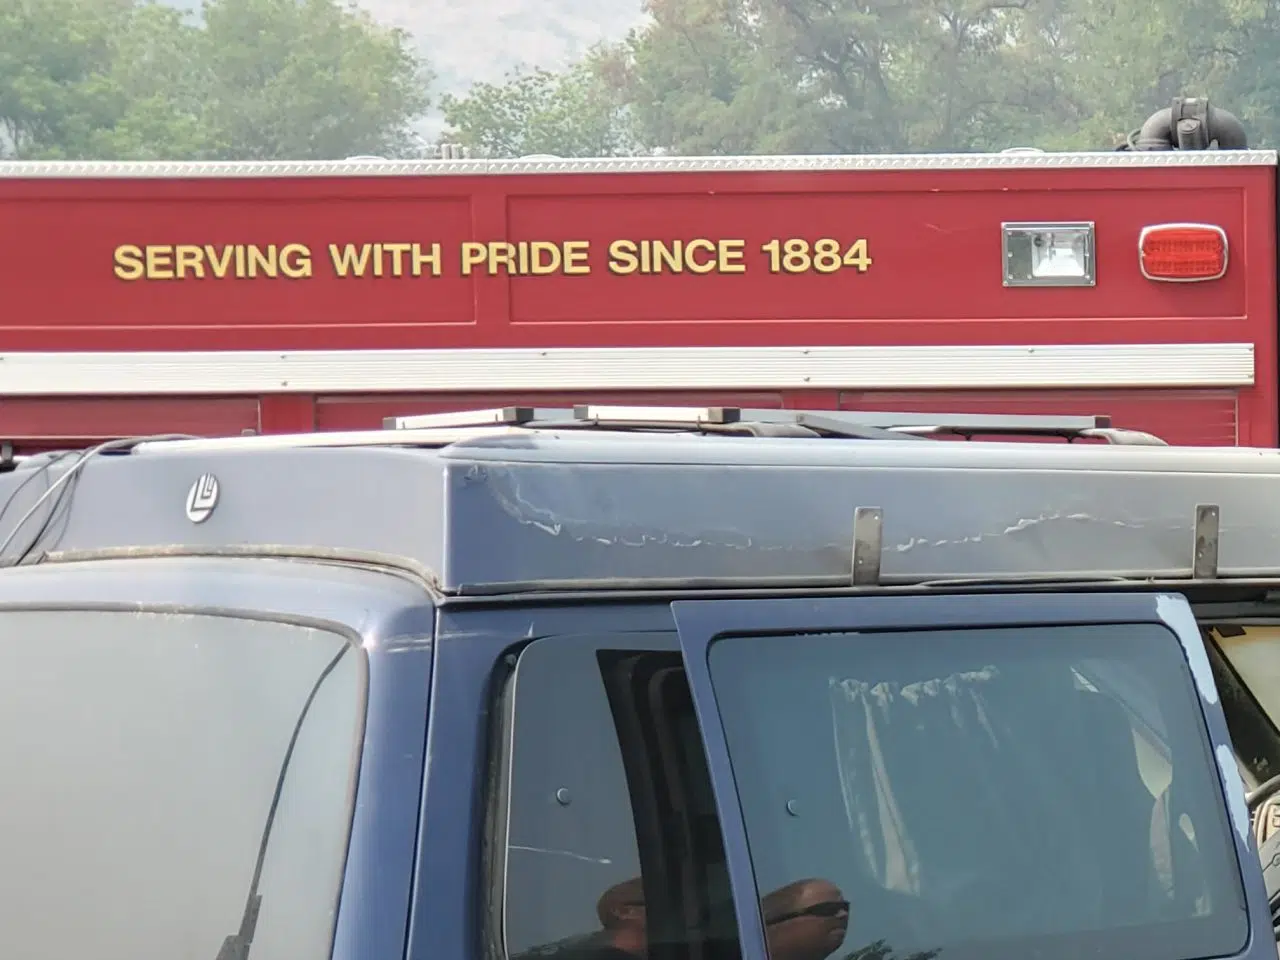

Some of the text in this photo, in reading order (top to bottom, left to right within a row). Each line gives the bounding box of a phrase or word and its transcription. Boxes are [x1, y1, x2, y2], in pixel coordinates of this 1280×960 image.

[113, 237, 872, 280] SERVING WITH PRIDE SINCE 1884
